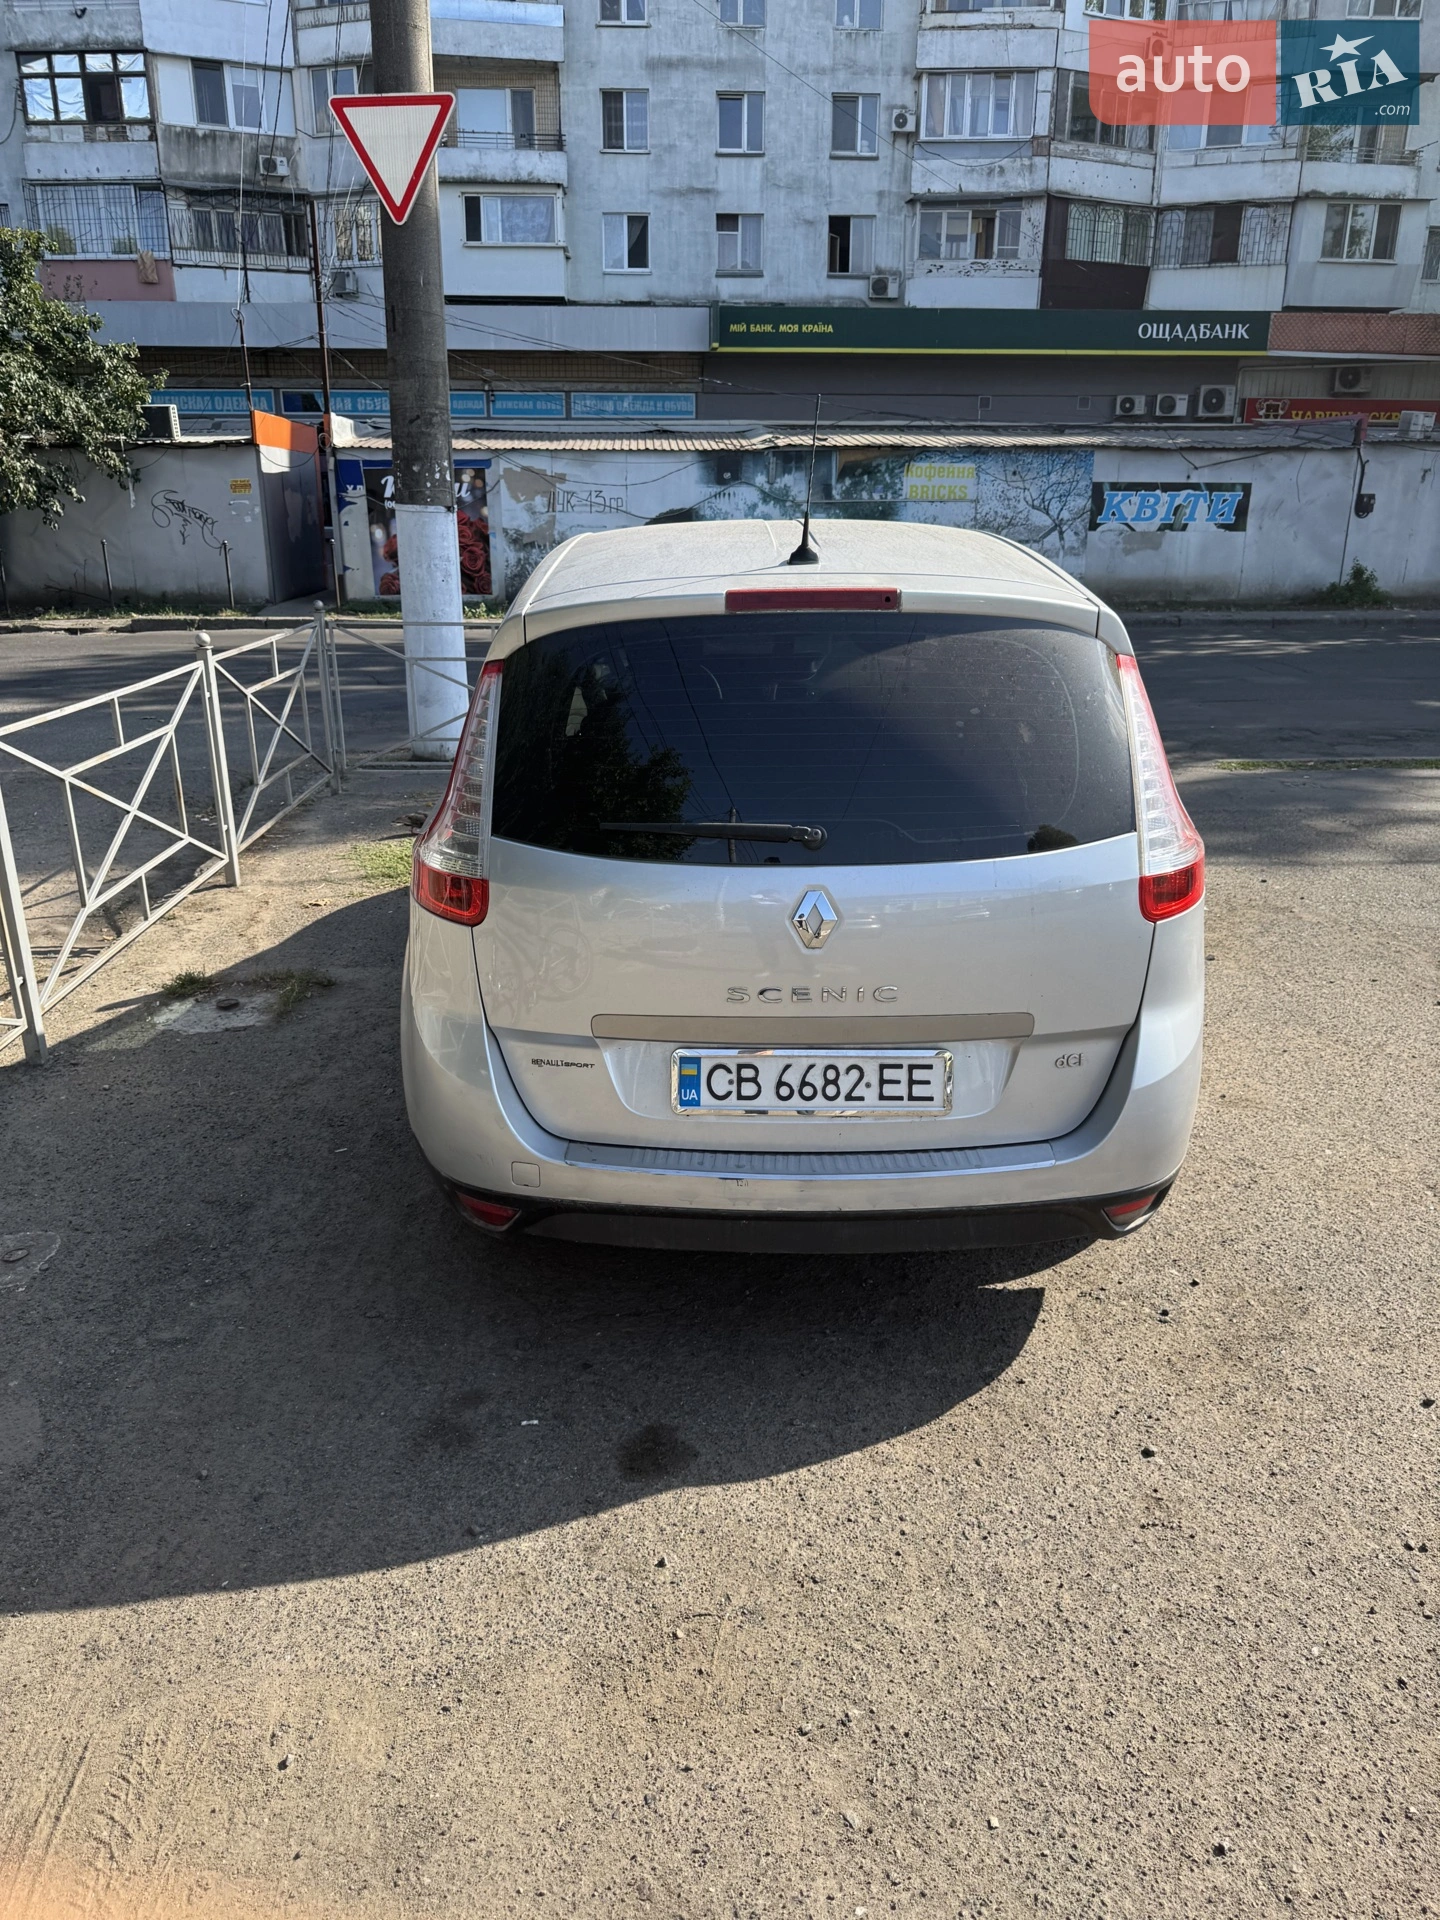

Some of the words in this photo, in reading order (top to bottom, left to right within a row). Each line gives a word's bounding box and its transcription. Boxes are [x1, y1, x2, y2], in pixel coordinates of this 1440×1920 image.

[729, 323, 747, 333] МІЙ
[750, 324, 776, 333] БАНК.
[779, 324, 799, 333] МОЯ
[802, 322, 833, 333] КРАЇНА
[1137, 322, 1250, 343] ОЩАДБАНК
[909, 484, 968, 499] BRICKS
[1097, 490, 1244, 524] КВІТИ
[726, 986, 899, 1003] SCENIC
[706, 1064, 762, 1101] CB
[775, 1064, 865, 1101] 6682
[878, 1064, 935, 1101] EE
[681, 1089, 698, 1101] UA
